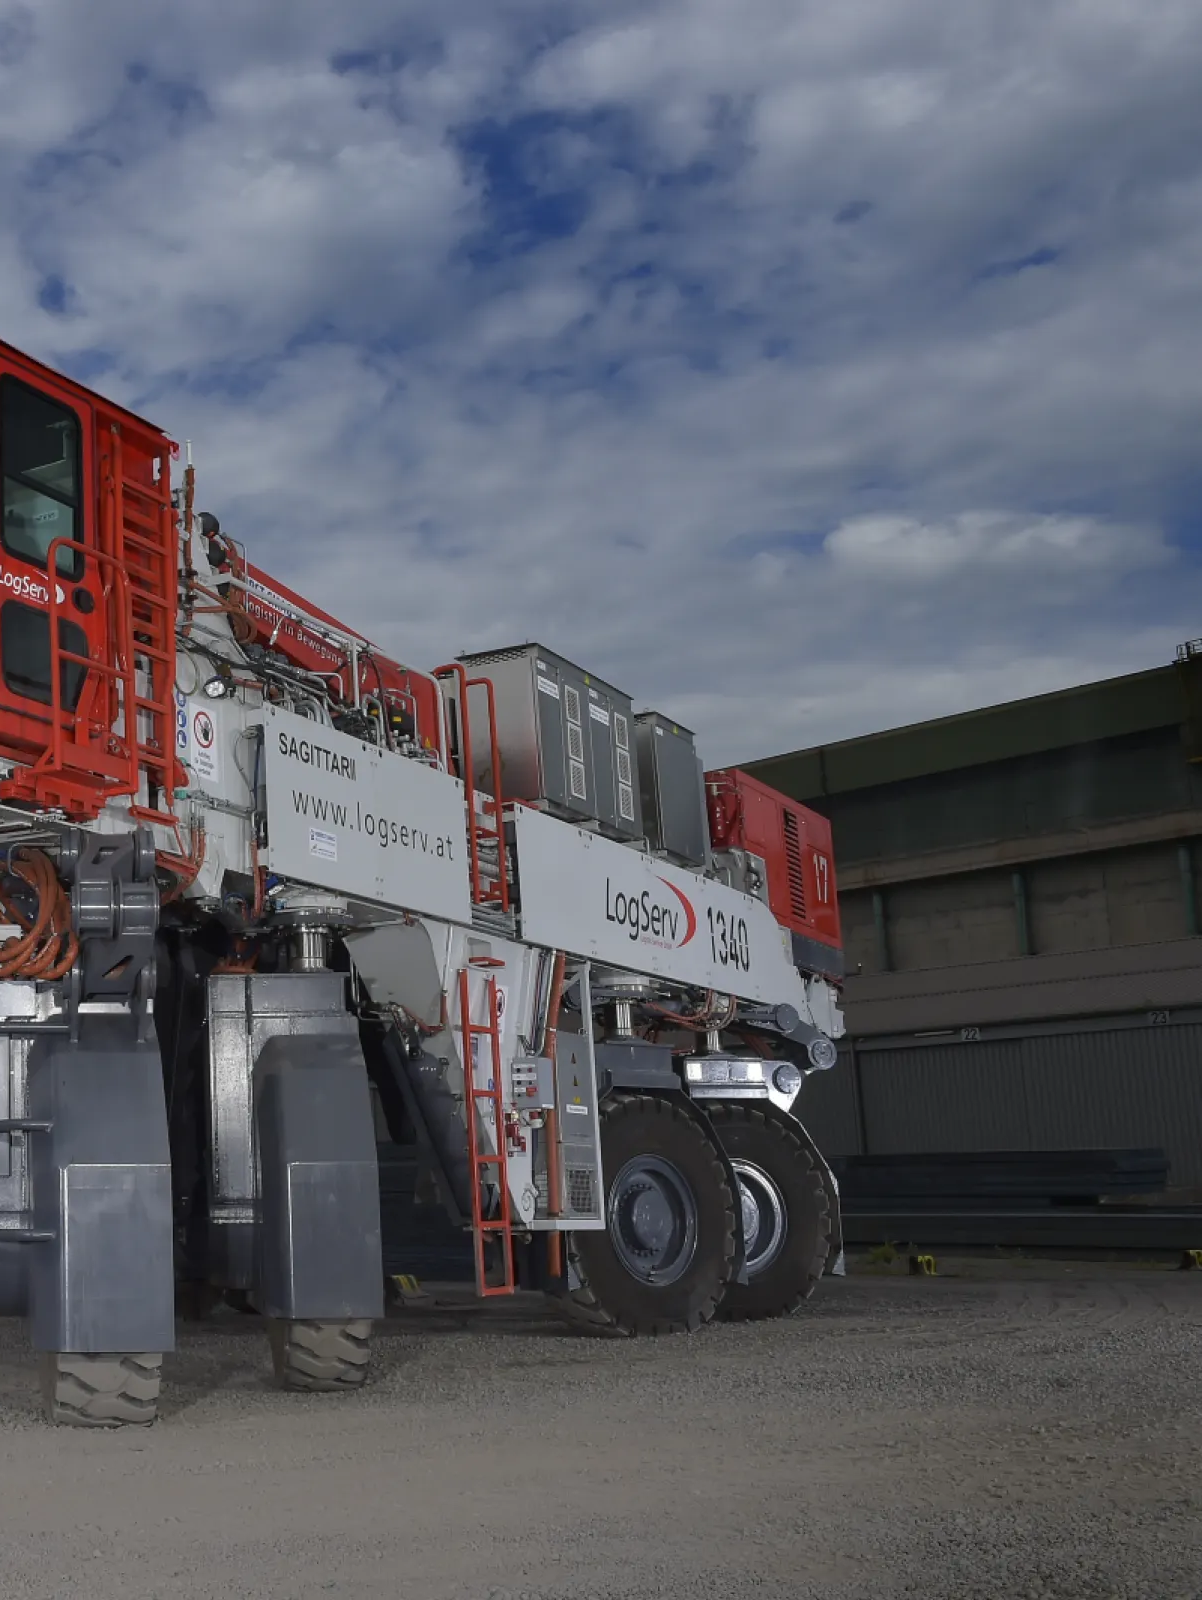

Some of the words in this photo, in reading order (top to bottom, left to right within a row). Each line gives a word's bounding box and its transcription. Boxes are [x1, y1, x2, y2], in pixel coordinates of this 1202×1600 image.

[292, 789, 454, 862] www.logserv.at
[812, 852, 828, 904] 17
[606, 876, 678, 941] LogServ
[707, 906, 750, 972] 1340
[964, 1029, 977, 1040] 22
[1151, 1012, 1166, 1023] 23
